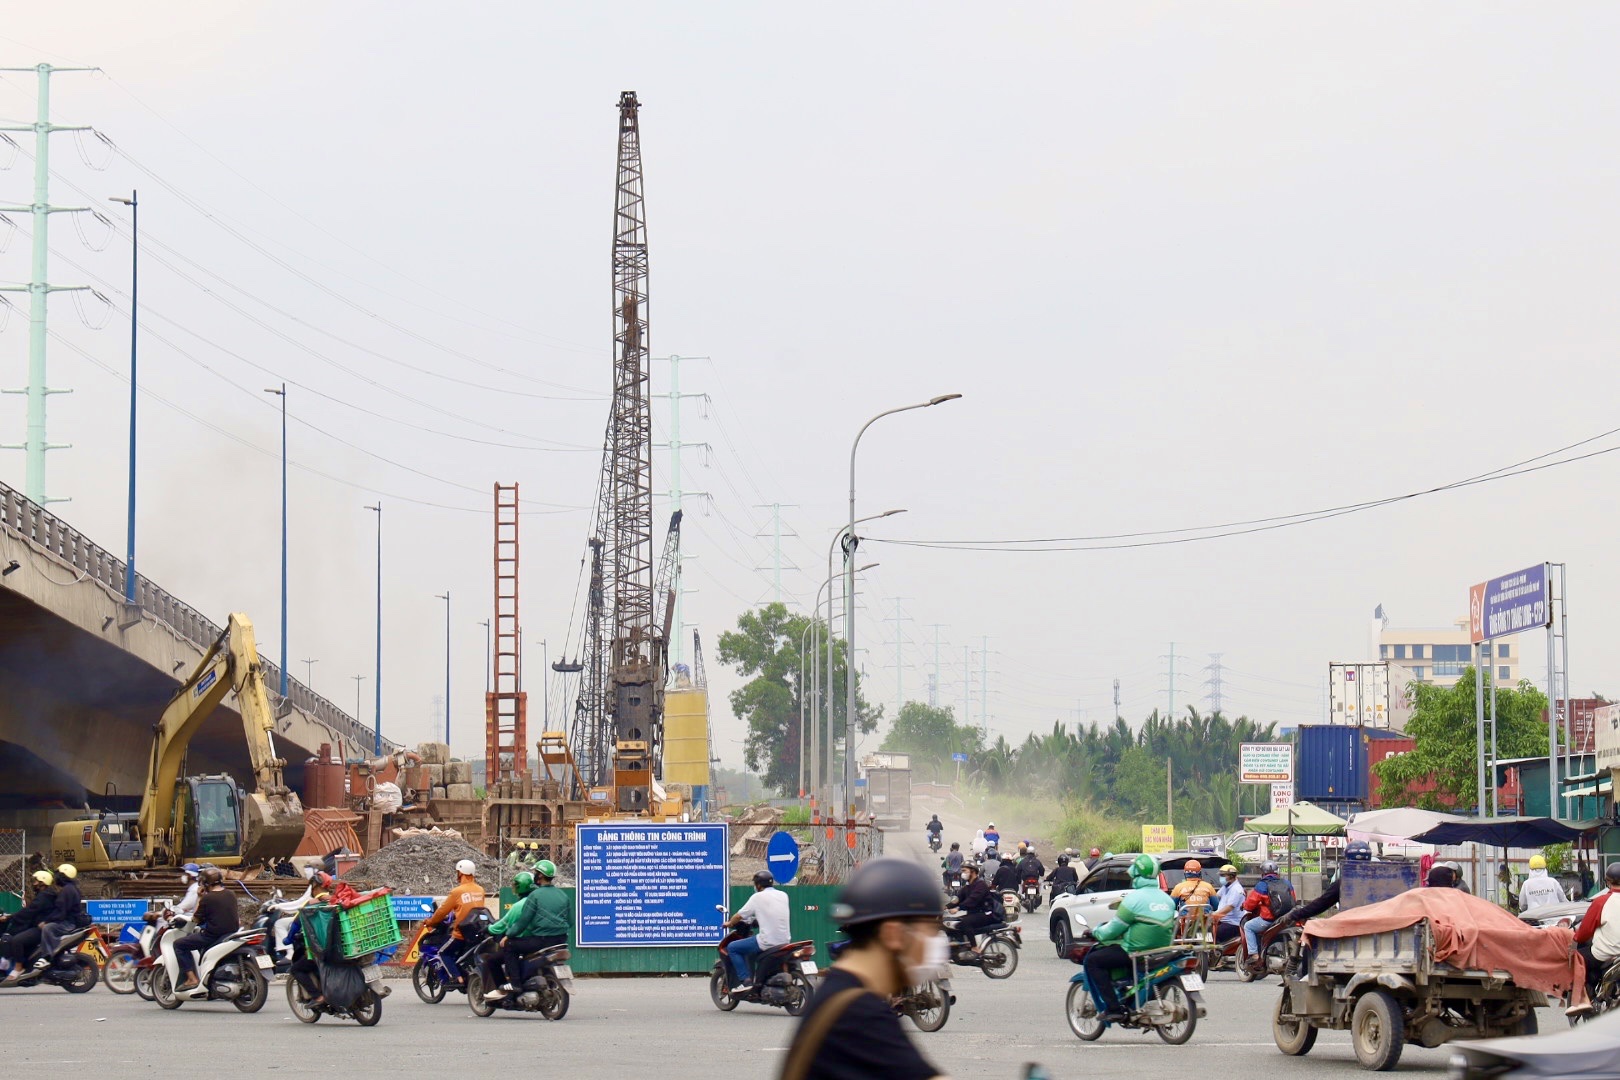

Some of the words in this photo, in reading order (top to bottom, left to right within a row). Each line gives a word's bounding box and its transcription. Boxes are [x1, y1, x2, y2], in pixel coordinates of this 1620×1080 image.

[598, 830, 618, 841] BẢNG
[620, 831, 645, 841] THÔNG
[648, 832, 659, 841] TIN
[662, 831, 682, 841] CÔNG
[684, 830, 706, 841] TRÌNH
